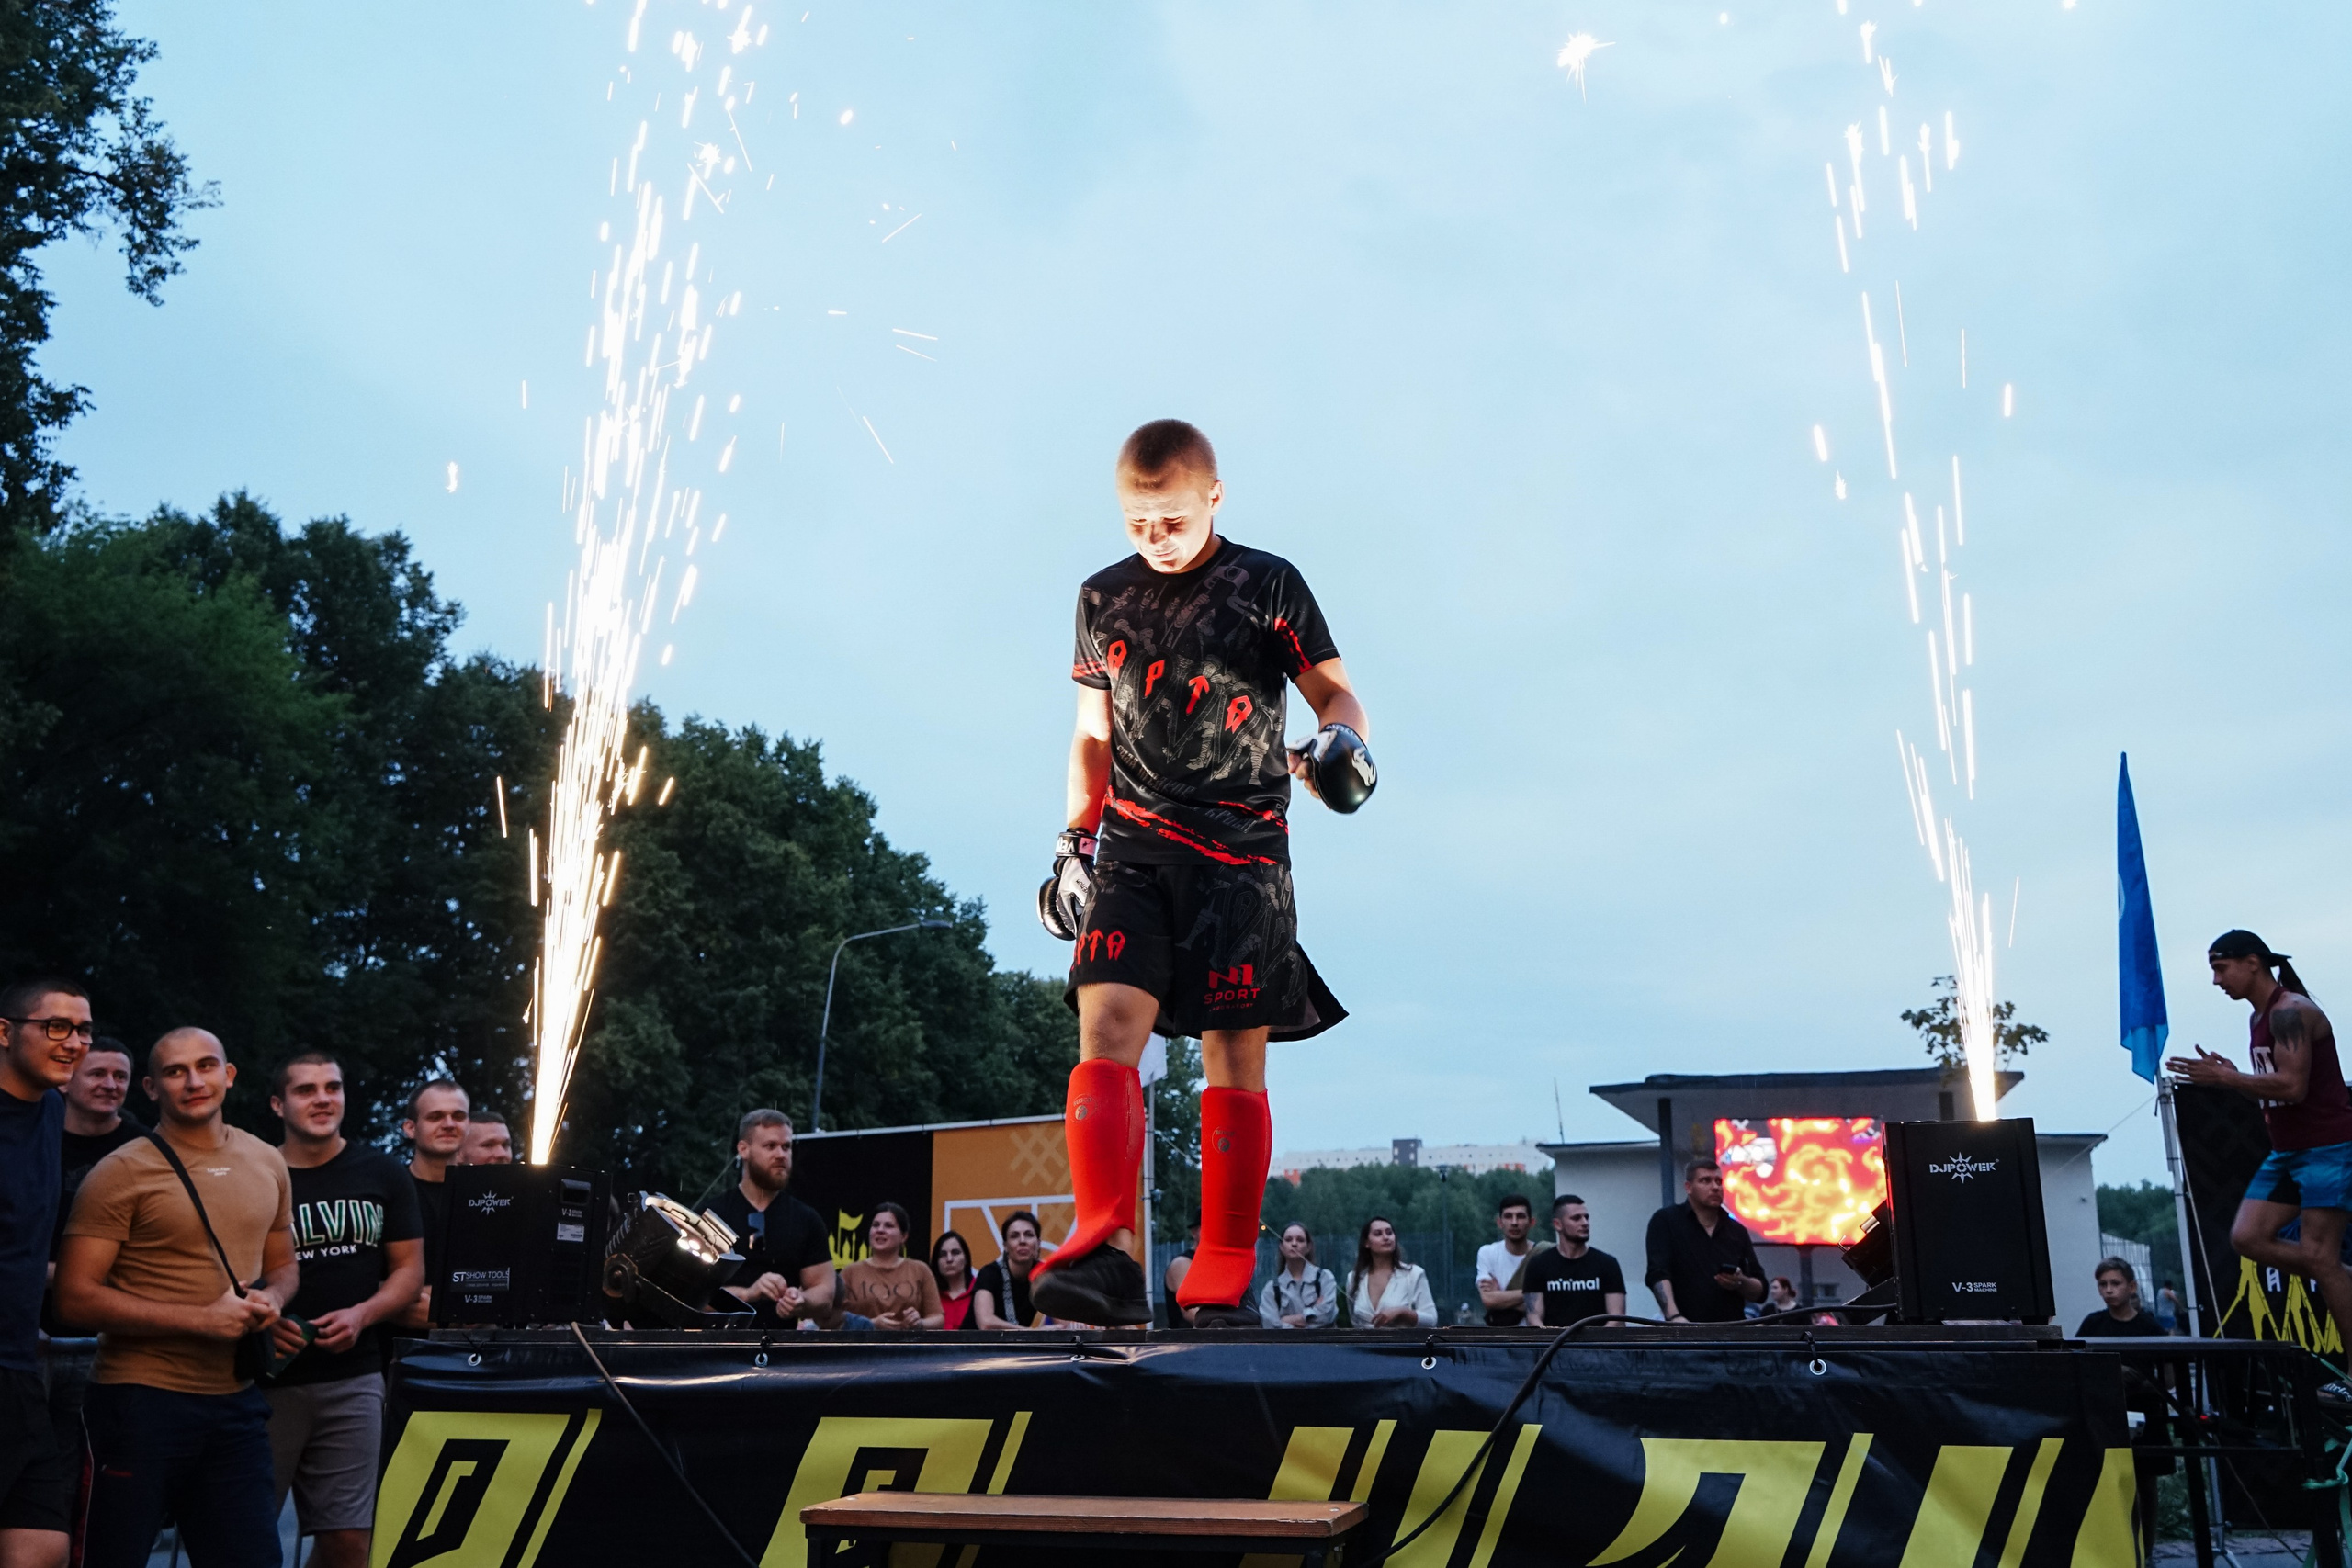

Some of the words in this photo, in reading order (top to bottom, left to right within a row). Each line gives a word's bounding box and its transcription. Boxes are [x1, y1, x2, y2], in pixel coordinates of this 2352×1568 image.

[1204, 988, 1260, 1005] SPORT
[1929, 1162, 1996, 1173] DJPOWER
[291, 1199, 384, 1247] LVIN
[295, 1250, 314, 1261] EW
[320, 1244, 357, 1258] YORK
[452, 1271, 466, 1282] ST
[466, 1270, 487, 1280] SHOW
[1951, 1281, 1973, 1292] V-3
[464, 1294, 478, 1303] V-3
